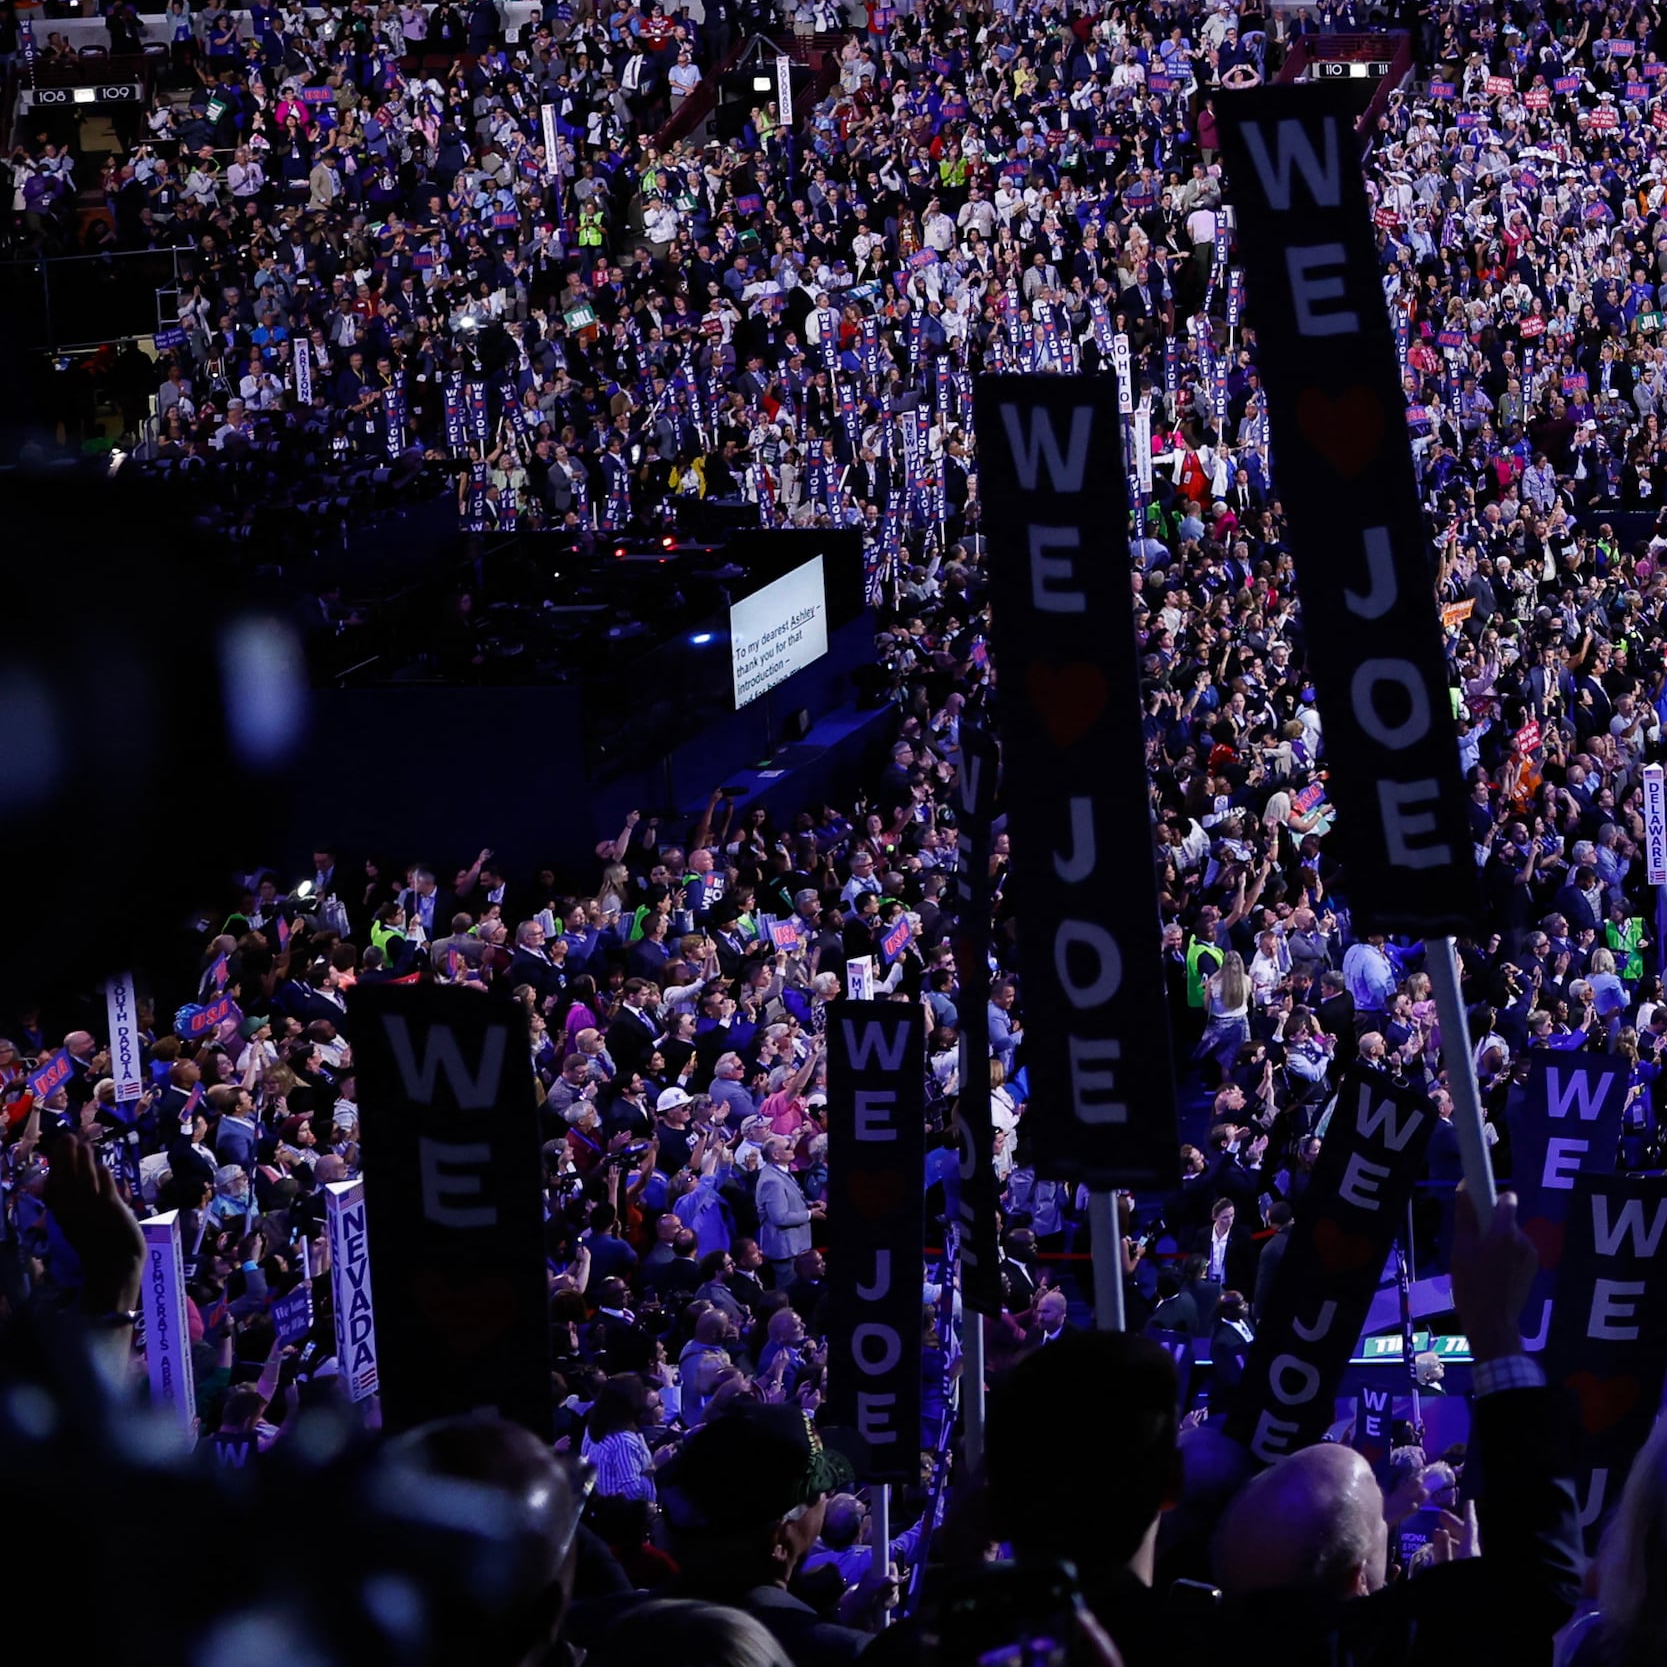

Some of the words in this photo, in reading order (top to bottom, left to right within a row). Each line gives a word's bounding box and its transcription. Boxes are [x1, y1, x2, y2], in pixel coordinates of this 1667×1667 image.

[38, 91, 65, 103] 108
[100, 87, 128, 99] 109
[780, 65, 789, 114] COLORADO
[1326, 64, 1341, 75] 110
[571, 310, 593, 328] JILL
[1117, 345, 1128, 402] OHIO
[1240, 118, 1360, 337] WE
[1343, 528, 1453, 870] JOE
[736, 647, 746, 660] To
[748, 639, 759, 653] my
[761, 620, 789, 645] dearest
[791, 605, 815, 628] Ashley
[737, 656, 758, 678] thank
[760, 648, 774, 667] you
[776, 640, 786, 654] for
[788, 630, 802, 646] that
[737, 660, 784, 695] introduction
[1000, 403, 1094, 614] WE
[1053, 795, 1128, 1125] JOE
[1648, 782, 1664, 869] DELAWARE
[113, 974, 128, 1024] SOUTH
[192, 997, 229, 1031] USA
[35, 1057, 69, 1095] USA
[117, 1028, 132, 1080] DAKOTA
[842, 1020, 911, 1141] WE
[382, 1015, 507, 1228] WE
[1339, 1081, 1426, 1212] WE
[151, 1250, 169, 1351] DEMOCRATS
[342, 1211, 373, 1375] NEVADA
[852, 1250, 902, 1446] JOE
[1250, 1299, 1338, 1463] JOE
